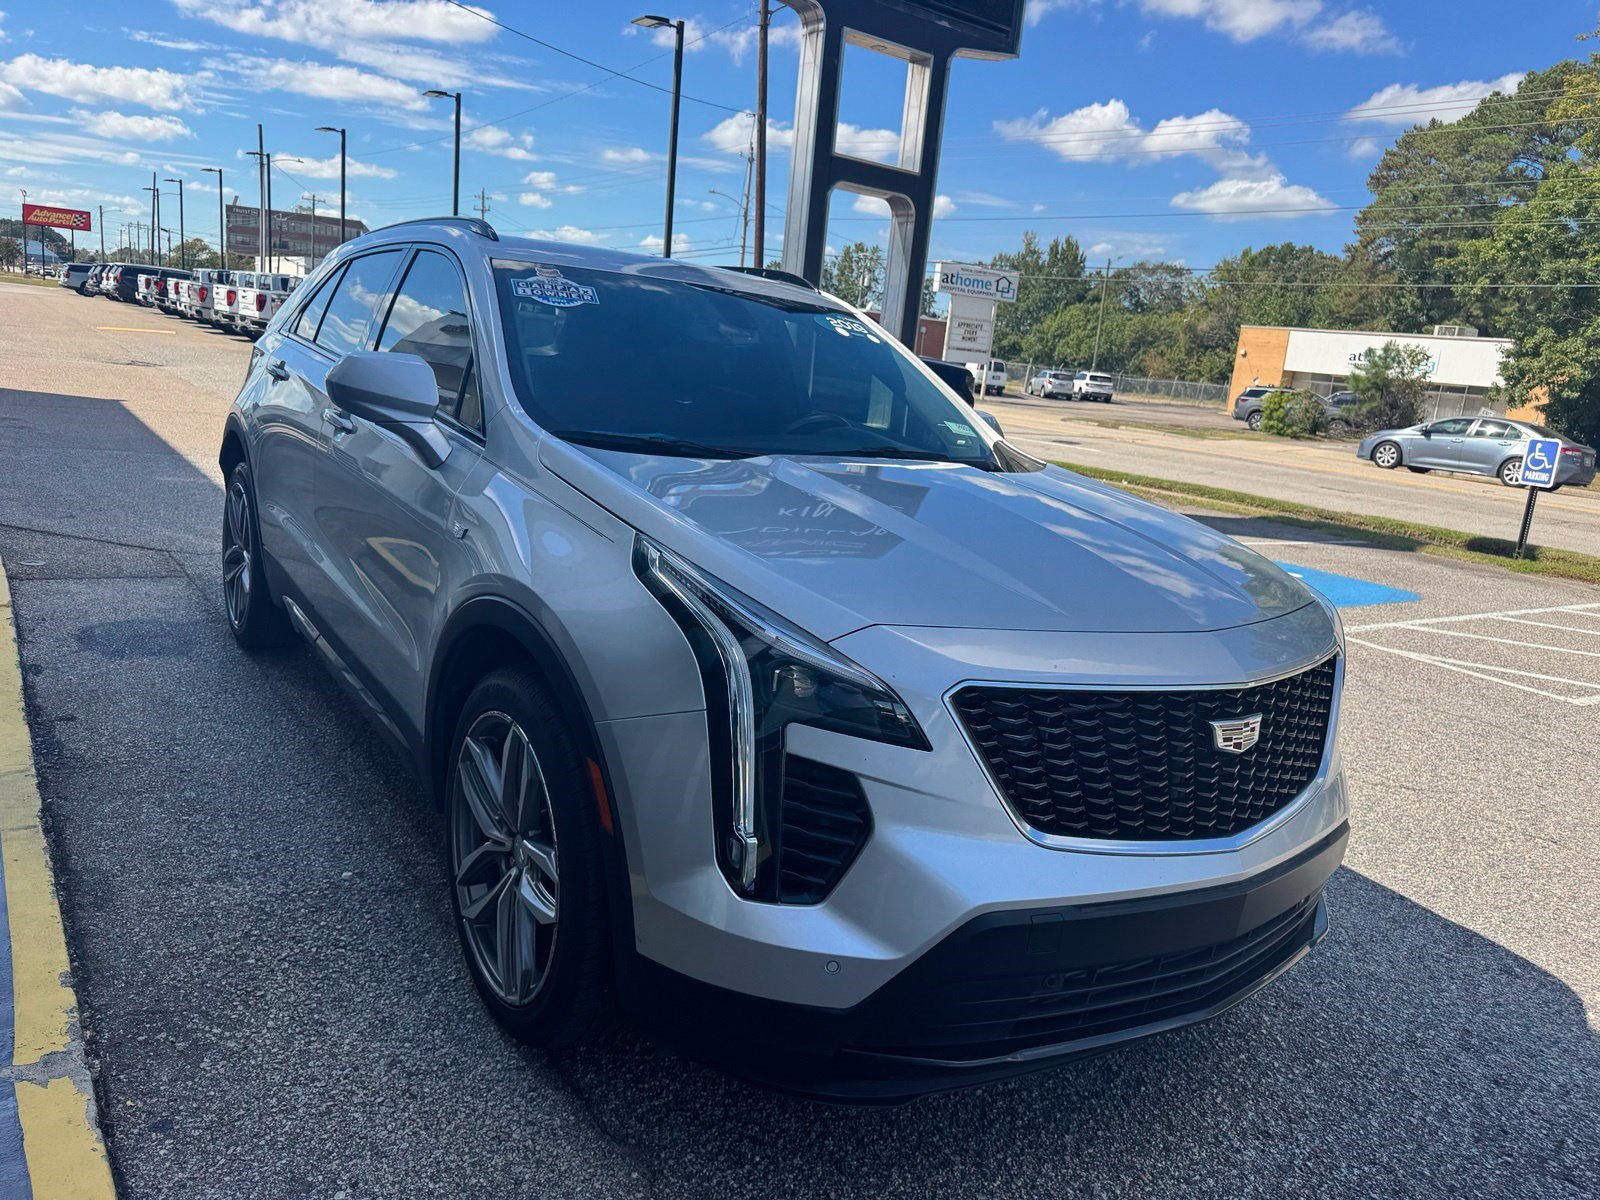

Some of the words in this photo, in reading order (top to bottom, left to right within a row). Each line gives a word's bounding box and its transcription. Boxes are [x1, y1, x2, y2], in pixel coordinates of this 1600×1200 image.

[27, 214, 48, 223] Auto
[49, 216, 70, 226] Parts
[32, 209, 72, 221] Advance
[942, 271, 993, 291] athome
[518, 281, 591, 295] CARFAX
[941, 284, 967, 294] HOSPITAL
[967, 288, 998, 298] EQUIPMENT
[532, 289, 594, 301] OWNER
[1524, 470, 1550, 482] PARKING
